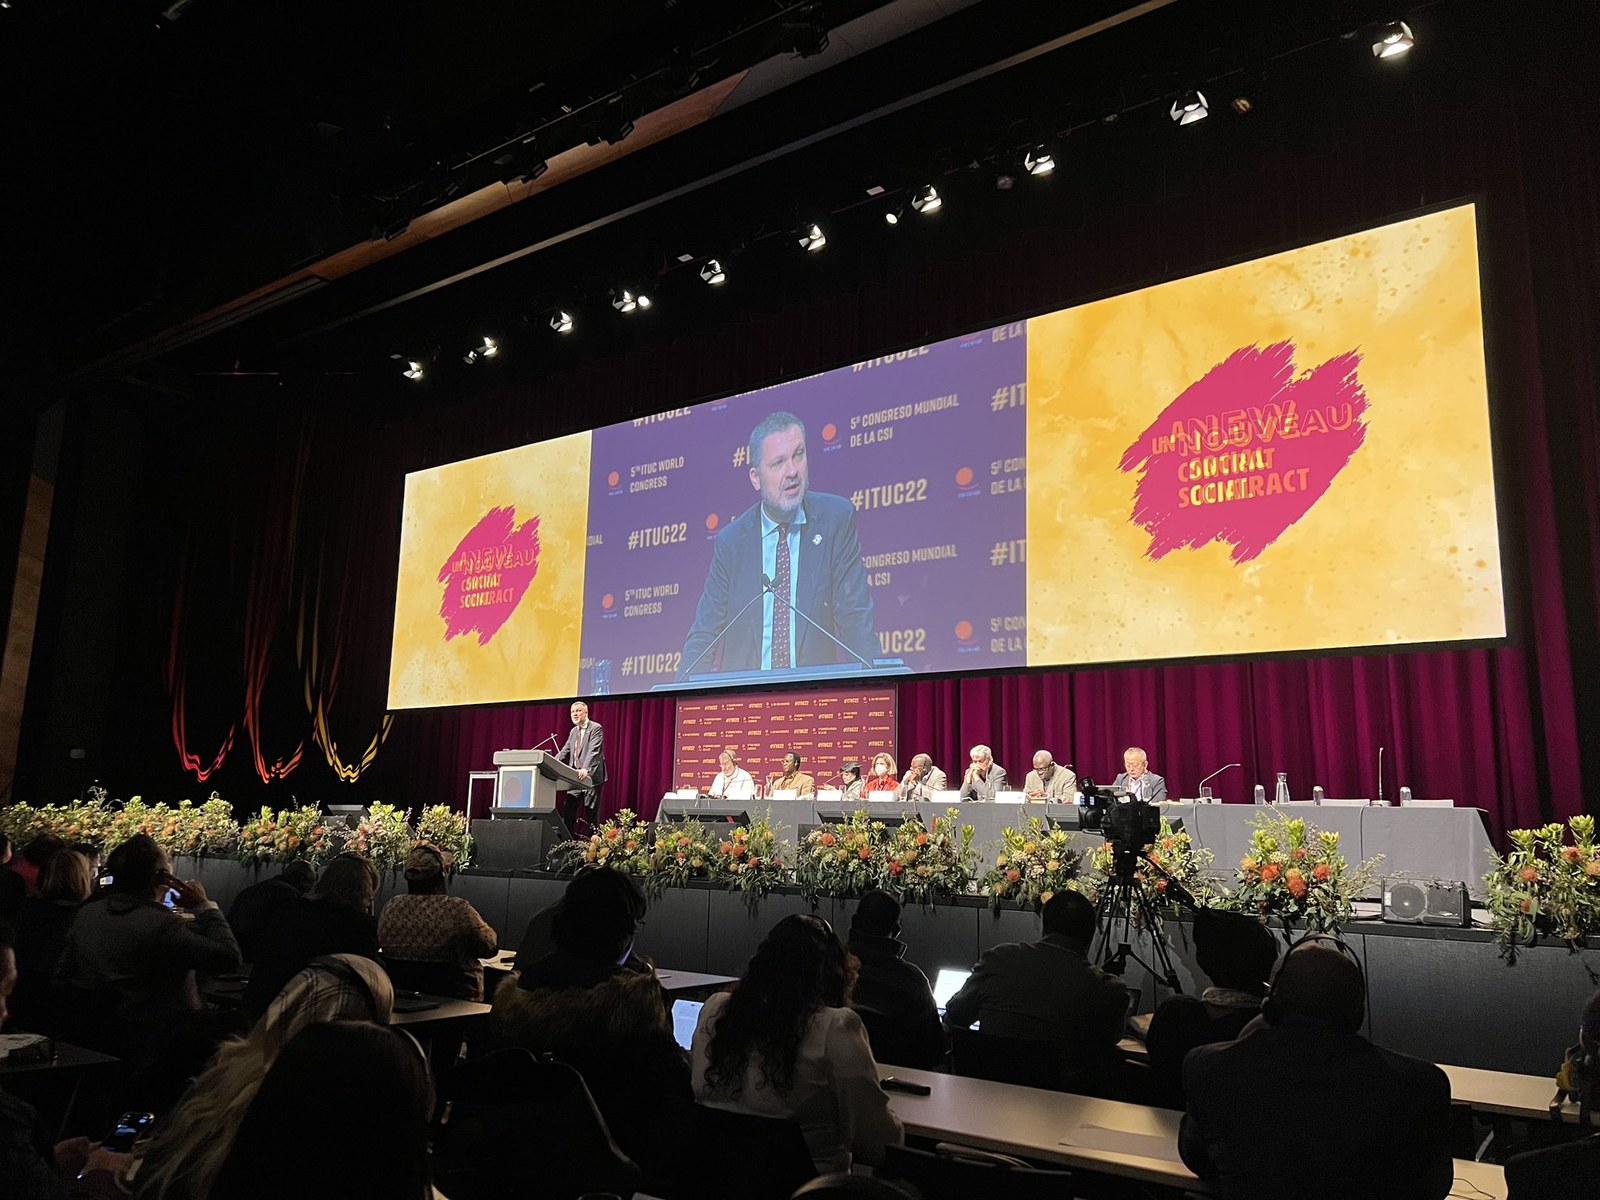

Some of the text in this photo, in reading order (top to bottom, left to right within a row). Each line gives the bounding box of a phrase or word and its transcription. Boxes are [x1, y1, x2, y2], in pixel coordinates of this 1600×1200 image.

[862, 404, 913, 427] CONGRESO
[914, 393, 960, 415] MUNDIAL
[850, 434, 862, 448] DE
[864, 432, 876, 445] LA
[877, 427, 893, 441] CSI
[641, 462, 657, 475] ITUC
[658, 456, 684, 472] WORLD
[630, 475, 668, 493] CONGRESS
[991, 480, 1006, 495] DE
[850, 478, 928, 511] #ITUC22
[628, 522, 687, 550] #ITUC22
[912, 543, 958, 562] MUNDIAL
[874, 572, 891, 586] CSI
[635, 586, 652, 599] ITUC
[653, 583, 679, 598] WORLD
[624, 602, 662, 617] CONGRESS
[880, 628, 926, 655] UC22
[991, 638, 1006, 653] DE
[1008, 637, 1023, 651] LA
[621, 652, 682, 676] #ITUC22
